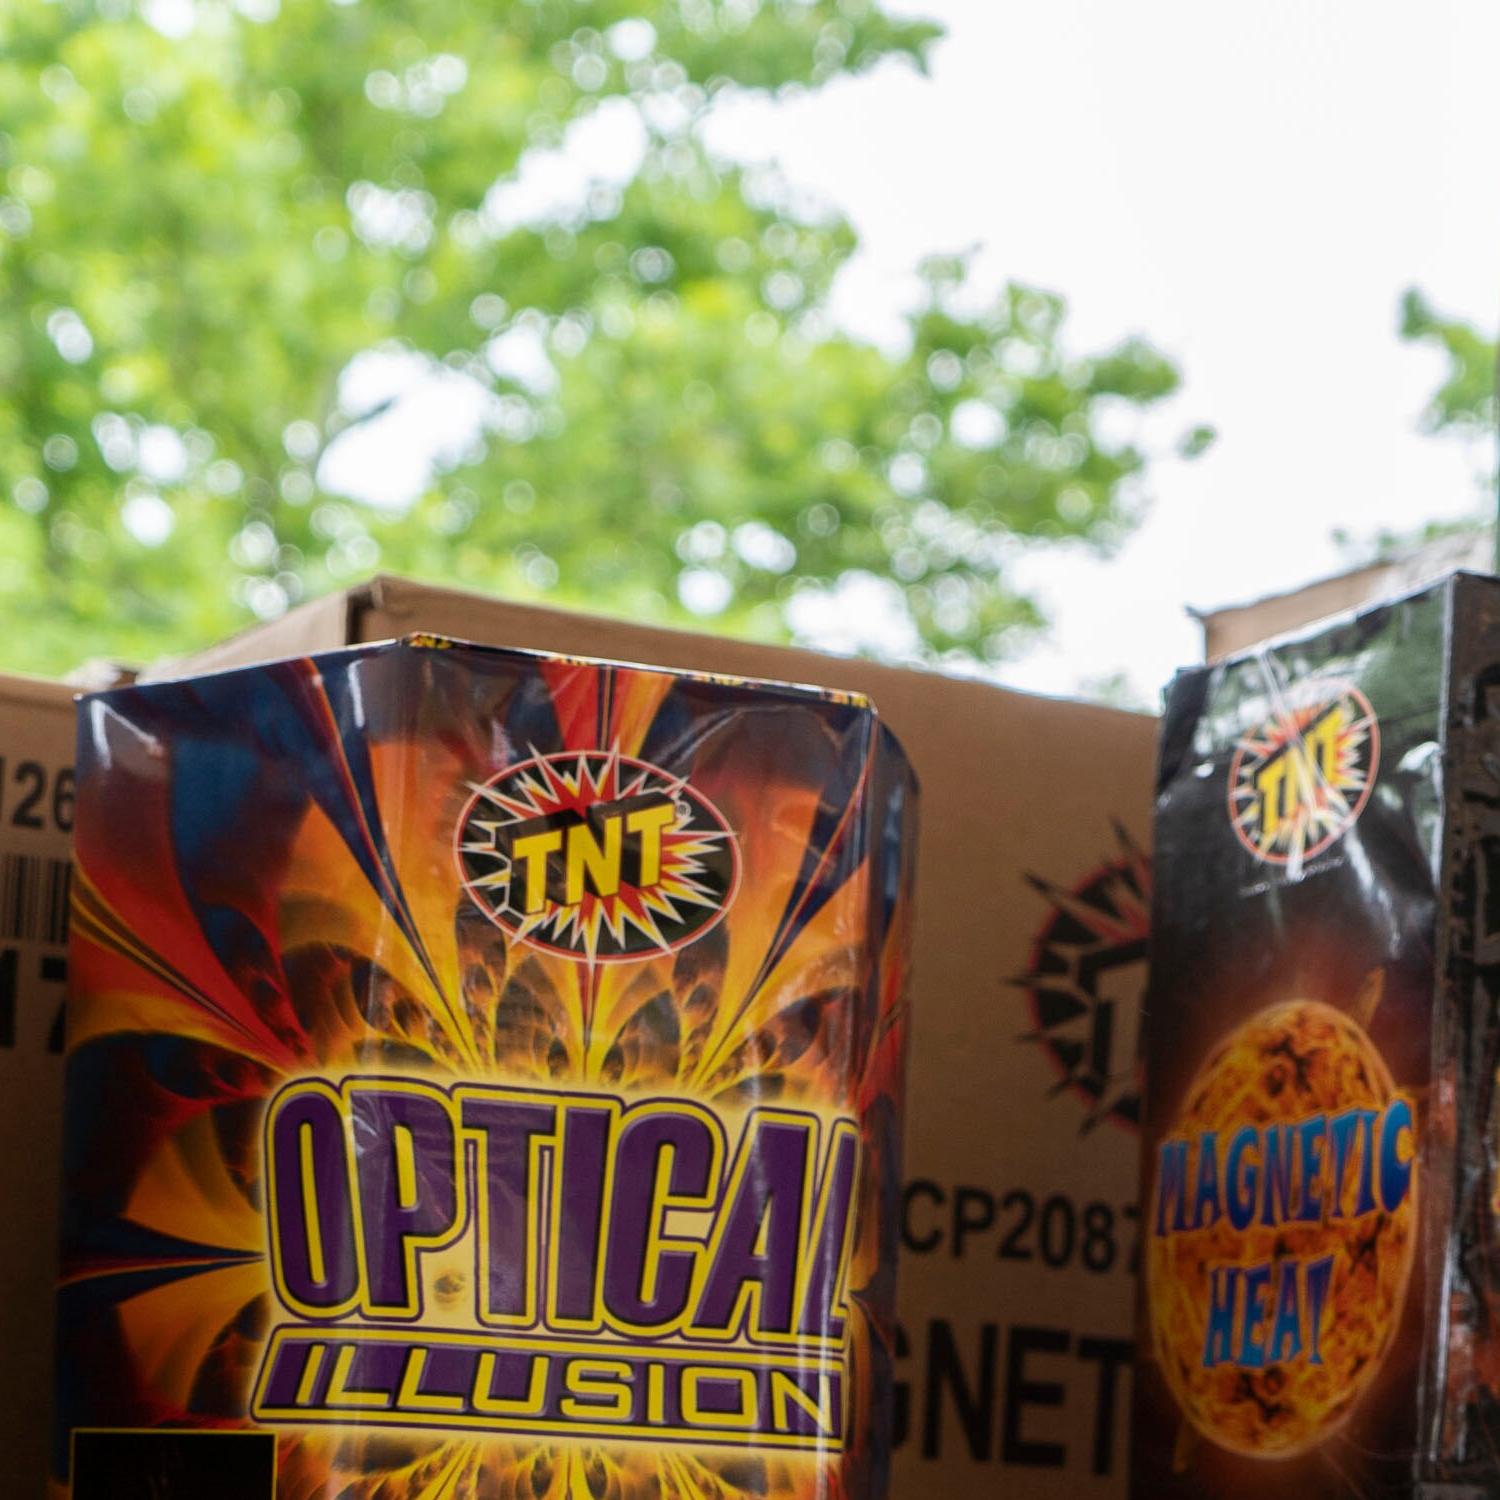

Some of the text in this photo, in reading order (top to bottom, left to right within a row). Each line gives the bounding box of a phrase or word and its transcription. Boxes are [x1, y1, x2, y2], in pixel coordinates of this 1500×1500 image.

[511, 802, 677, 914] TNT
[266, 1077, 859, 1343] OPTICAL
[1155, 1099, 1415, 1239] MAGNETIC
[1202, 1253, 1335, 1370] HEAT
[294, 1344, 833, 1433] ILLUSION
